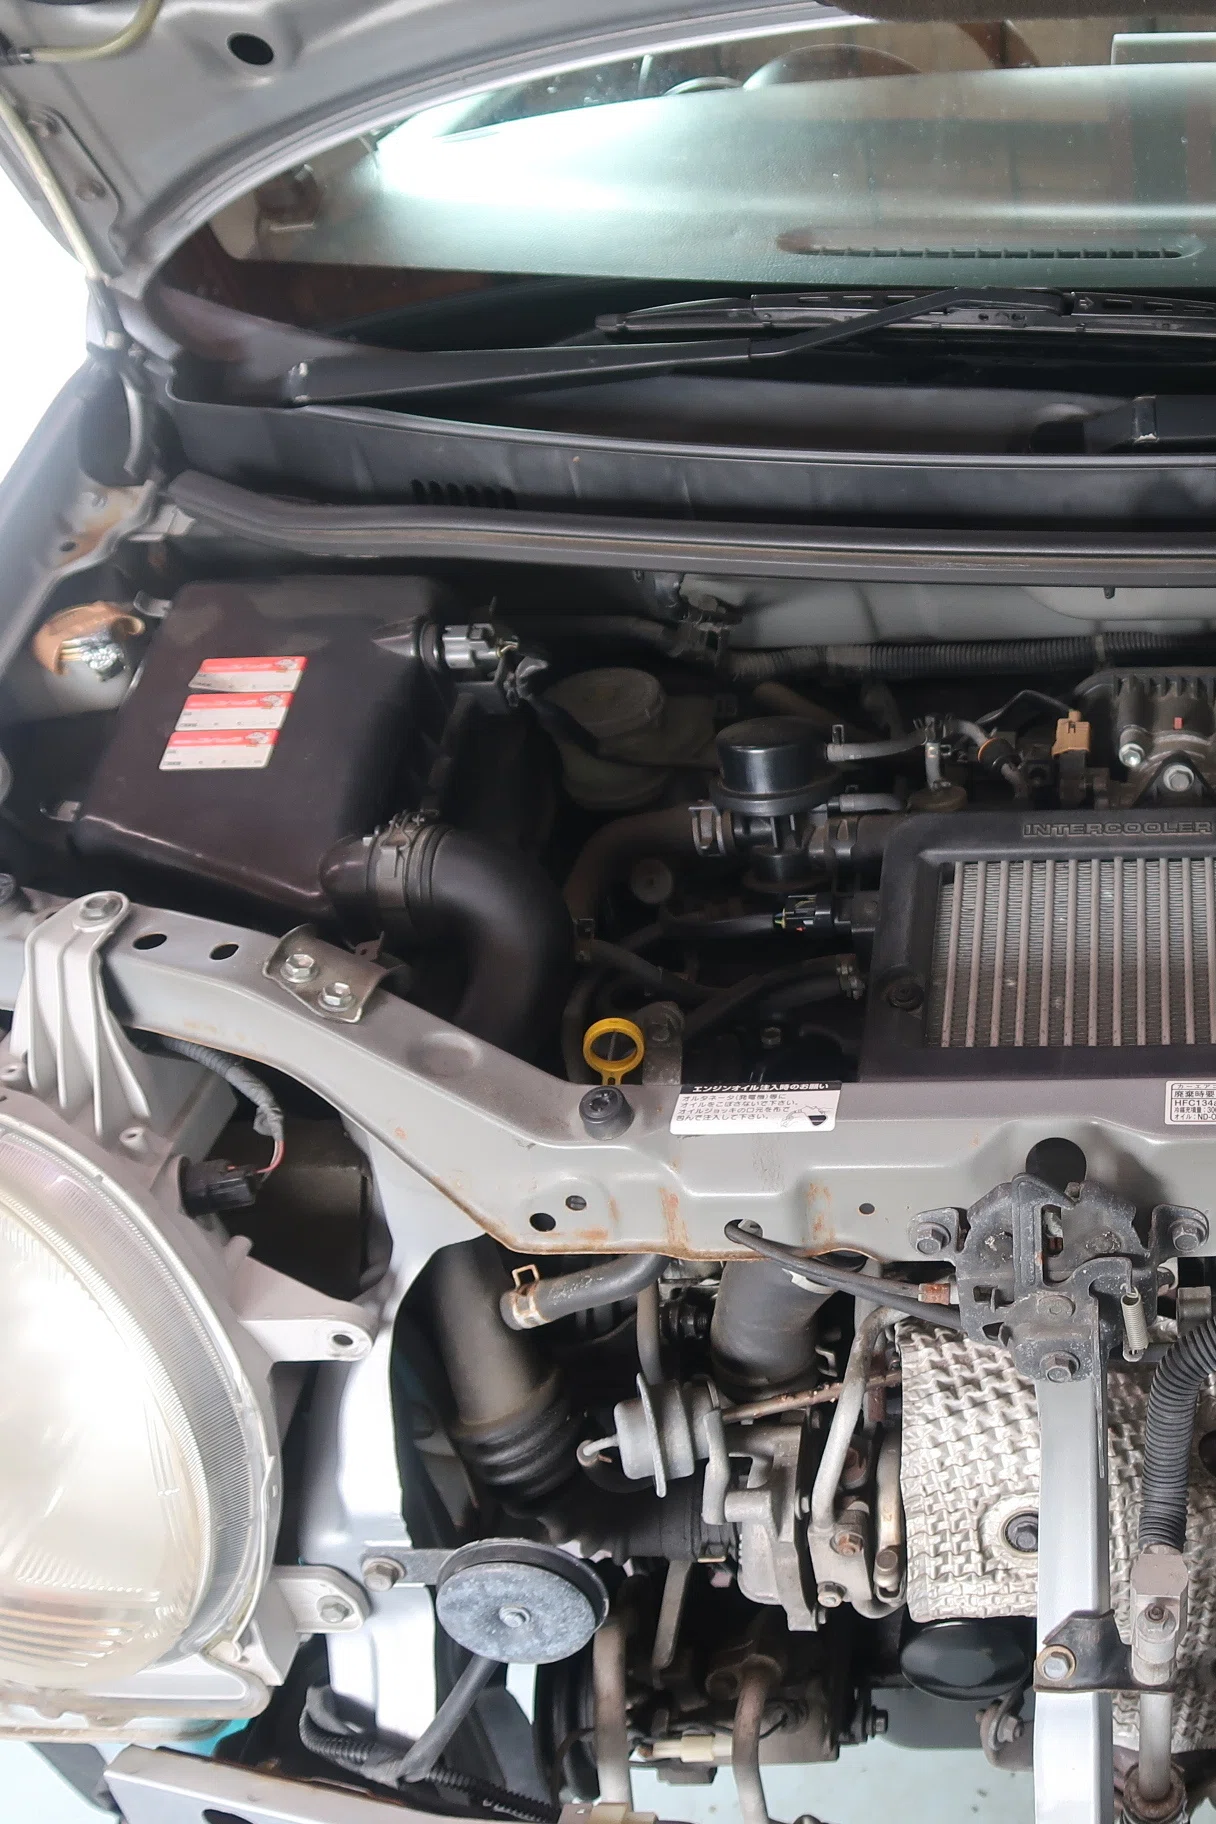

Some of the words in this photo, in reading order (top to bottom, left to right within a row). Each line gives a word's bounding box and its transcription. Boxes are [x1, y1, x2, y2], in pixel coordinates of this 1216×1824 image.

[1023, 821, 1215, 837] INTERCOOLER
[692, 1083, 829, 1092] エンジンオイル注入時のお願い
